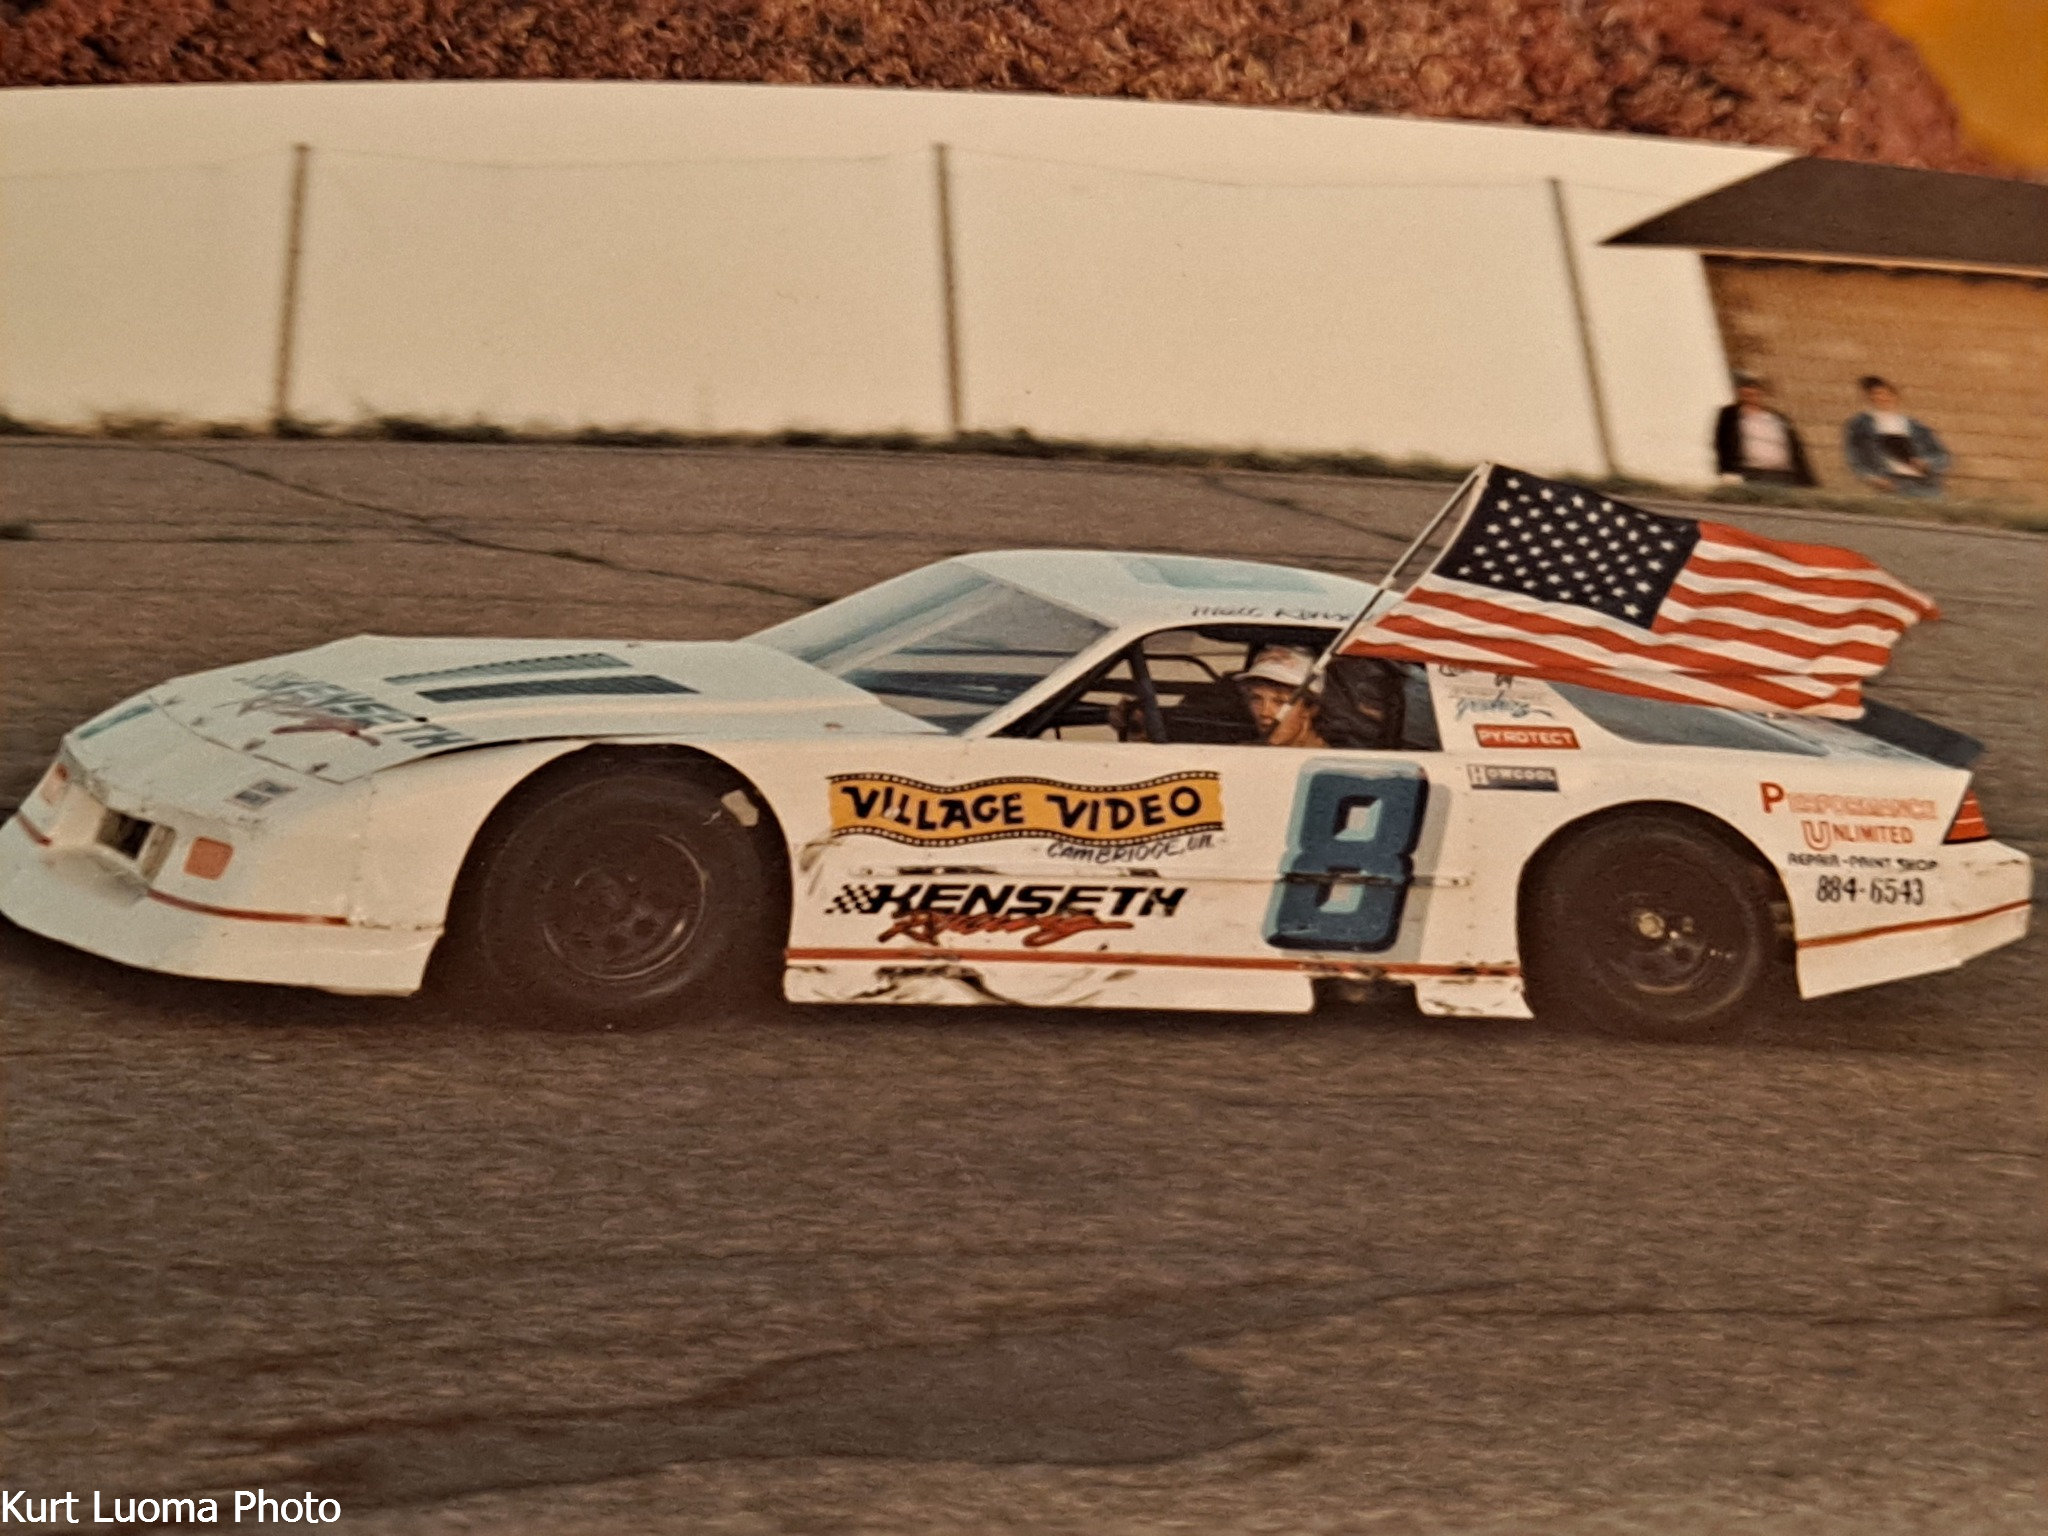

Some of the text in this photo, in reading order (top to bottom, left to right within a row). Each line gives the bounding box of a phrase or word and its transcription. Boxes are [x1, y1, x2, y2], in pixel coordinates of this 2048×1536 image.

[1479, 729, 1573, 745] PYROTECT
[841, 786, 1203, 832] VILLAGE VIDEO
[1802, 820, 1914, 850] UNLIMITED
[1262, 757, 1432, 954] 8
[862, 883, 1188, 919] KENSETH
[1816, 874, 1925, 905] 884-6543
